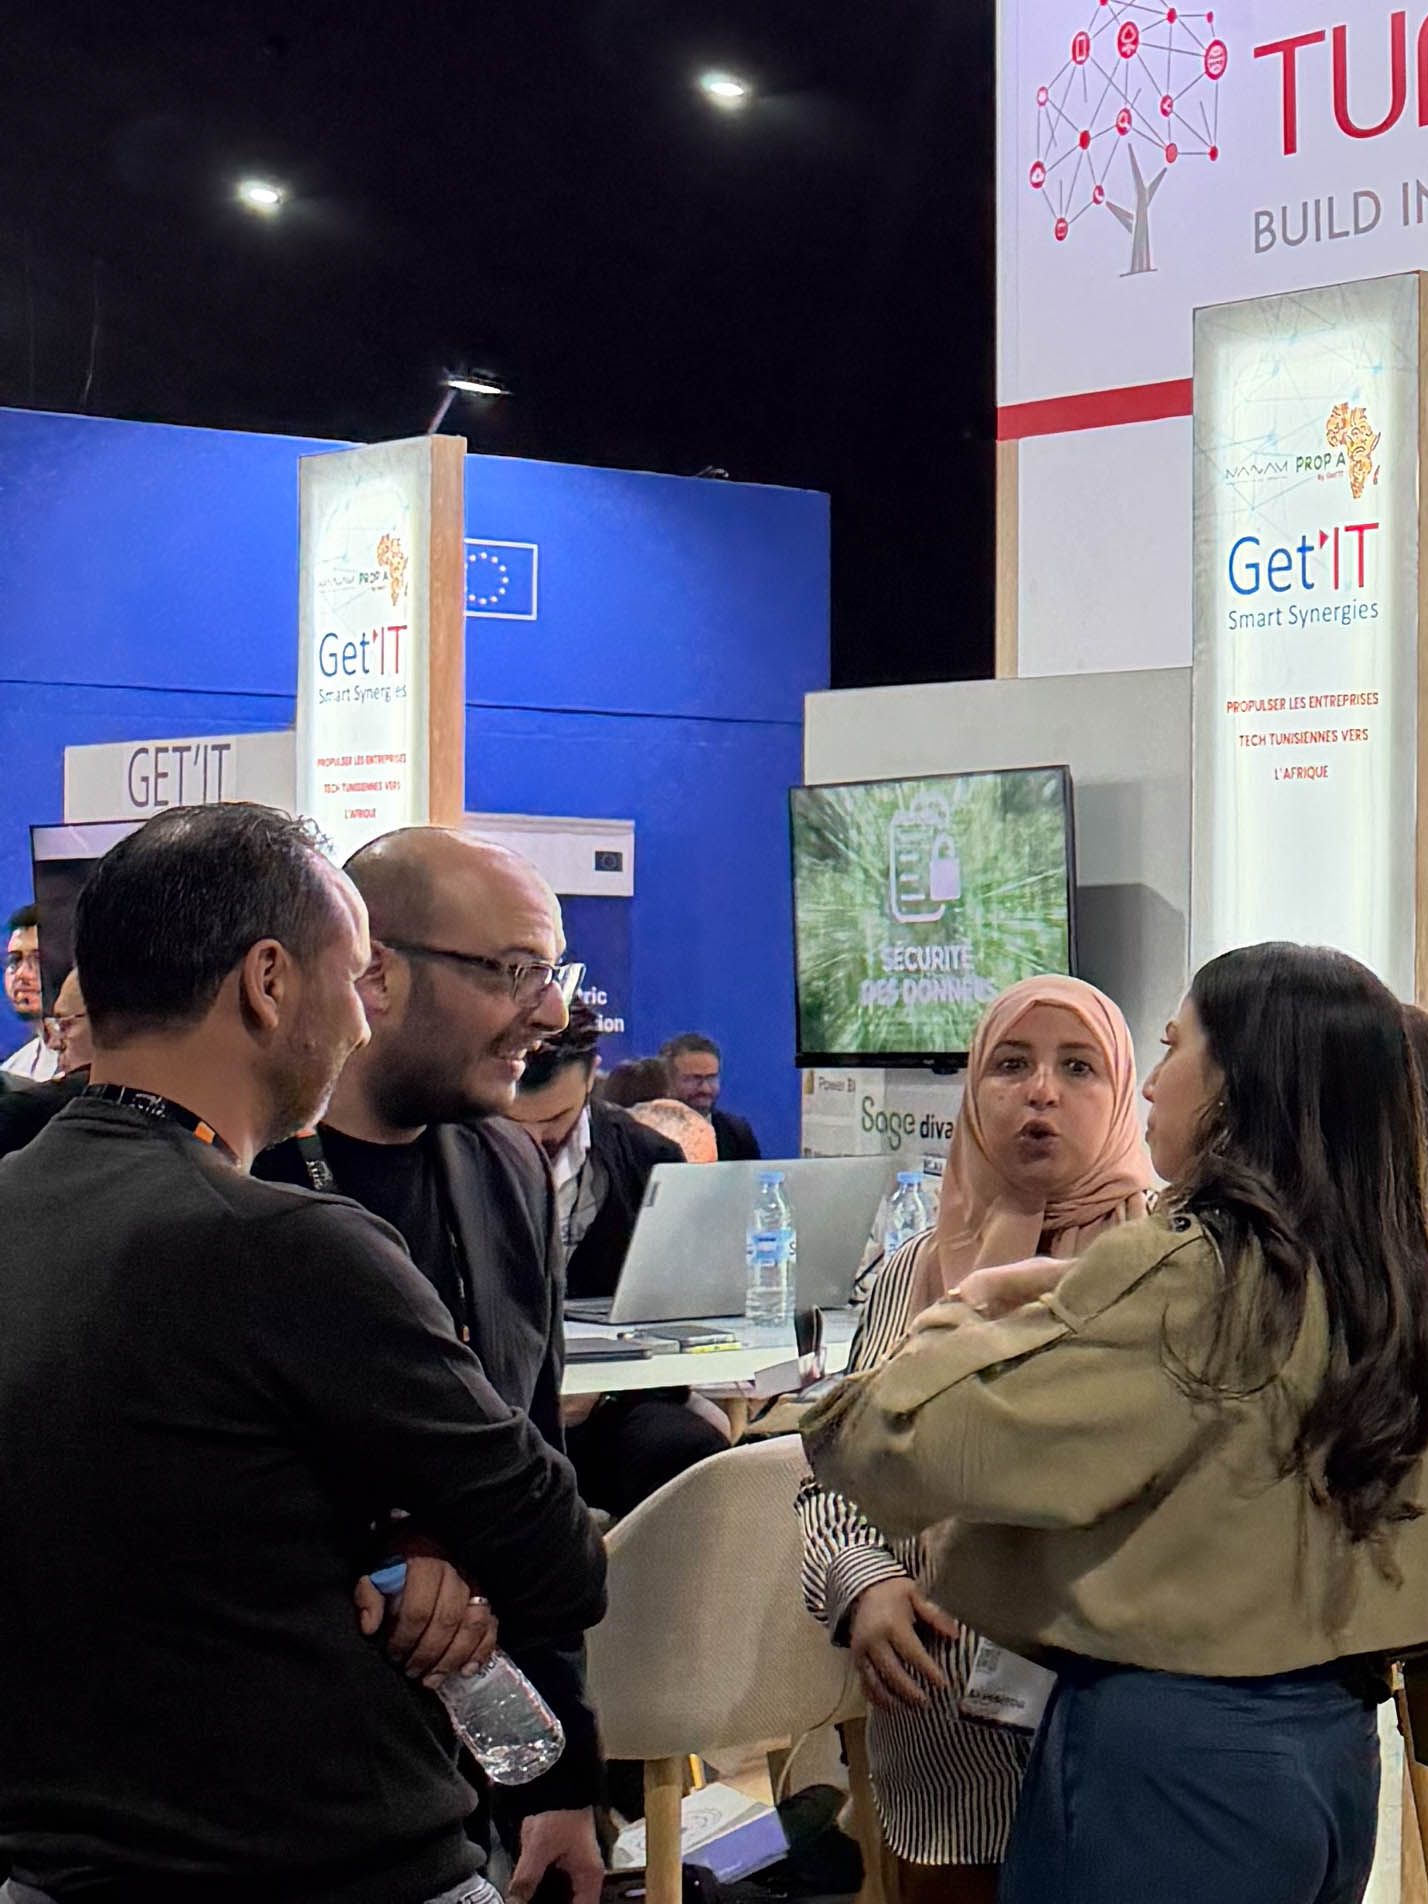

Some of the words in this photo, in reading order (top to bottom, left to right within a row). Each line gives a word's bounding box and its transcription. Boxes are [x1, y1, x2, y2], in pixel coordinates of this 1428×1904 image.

[1255, 186, 1381, 254] BUILD
[1296, 453, 1331, 473] PROP
[1228, 522, 1379, 595] Get'IT
[1228, 607, 1282, 630] Smart
[1288, 599, 1379, 629] Synergies
[319, 625, 408, 677] Get'IT
[1226, 696, 1286, 713] PROPULSER
[1289, 696, 1306, 710] LES
[1309, 692, 1379, 710] ENTREPRISES
[1239, 733, 1267, 747] TECH
[1270, 729, 1338, 746] TUNISIENNES
[1341, 728, 1369, 743] VERS
[127, 743, 232, 808] GET'IT
[1274, 765, 1329, 781] L'AFRIQUE
[594, 1014, 625, 1033] ion
[861, 1095, 916, 1151] Sage
